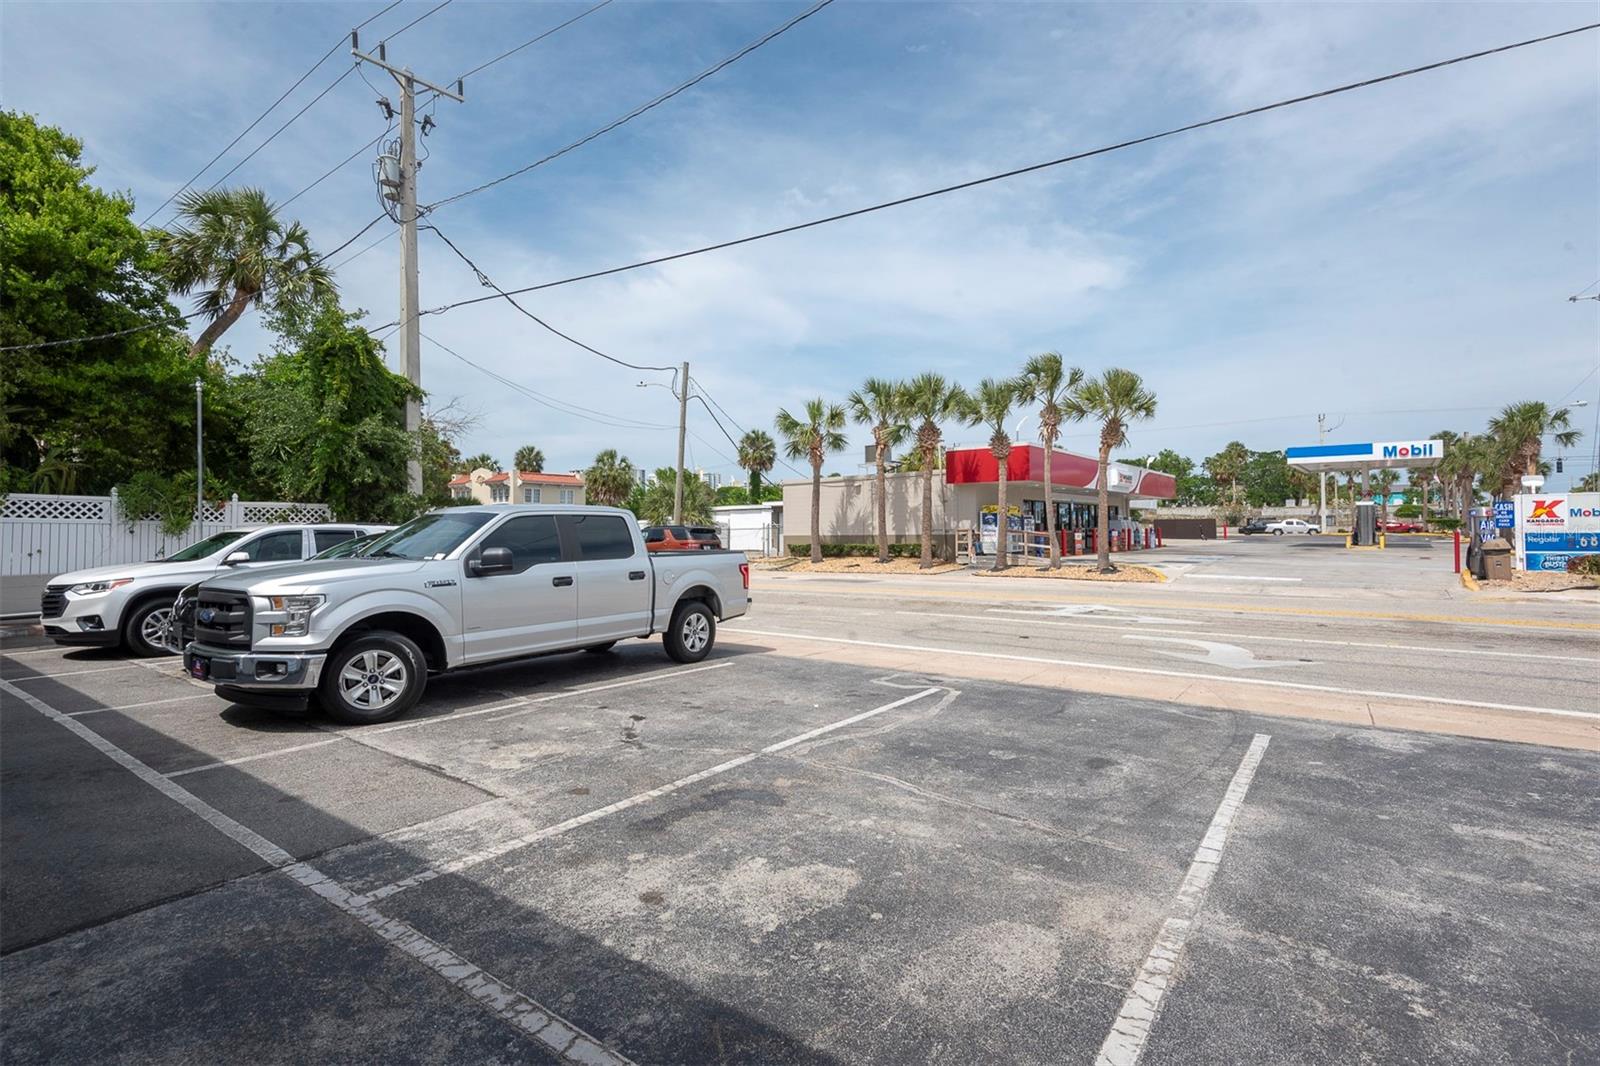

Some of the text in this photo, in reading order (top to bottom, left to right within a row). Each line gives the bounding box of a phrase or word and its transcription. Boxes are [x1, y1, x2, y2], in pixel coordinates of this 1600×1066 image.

[1383, 444, 1433, 458] Mobil
[1494, 503, 1514, 511] CASH
[1569, 508, 1600, 517] Mob
[1480, 520, 1495, 530] AIR
[1480, 534, 1496, 543] VAC
[1527, 535, 1561, 544] Regular
